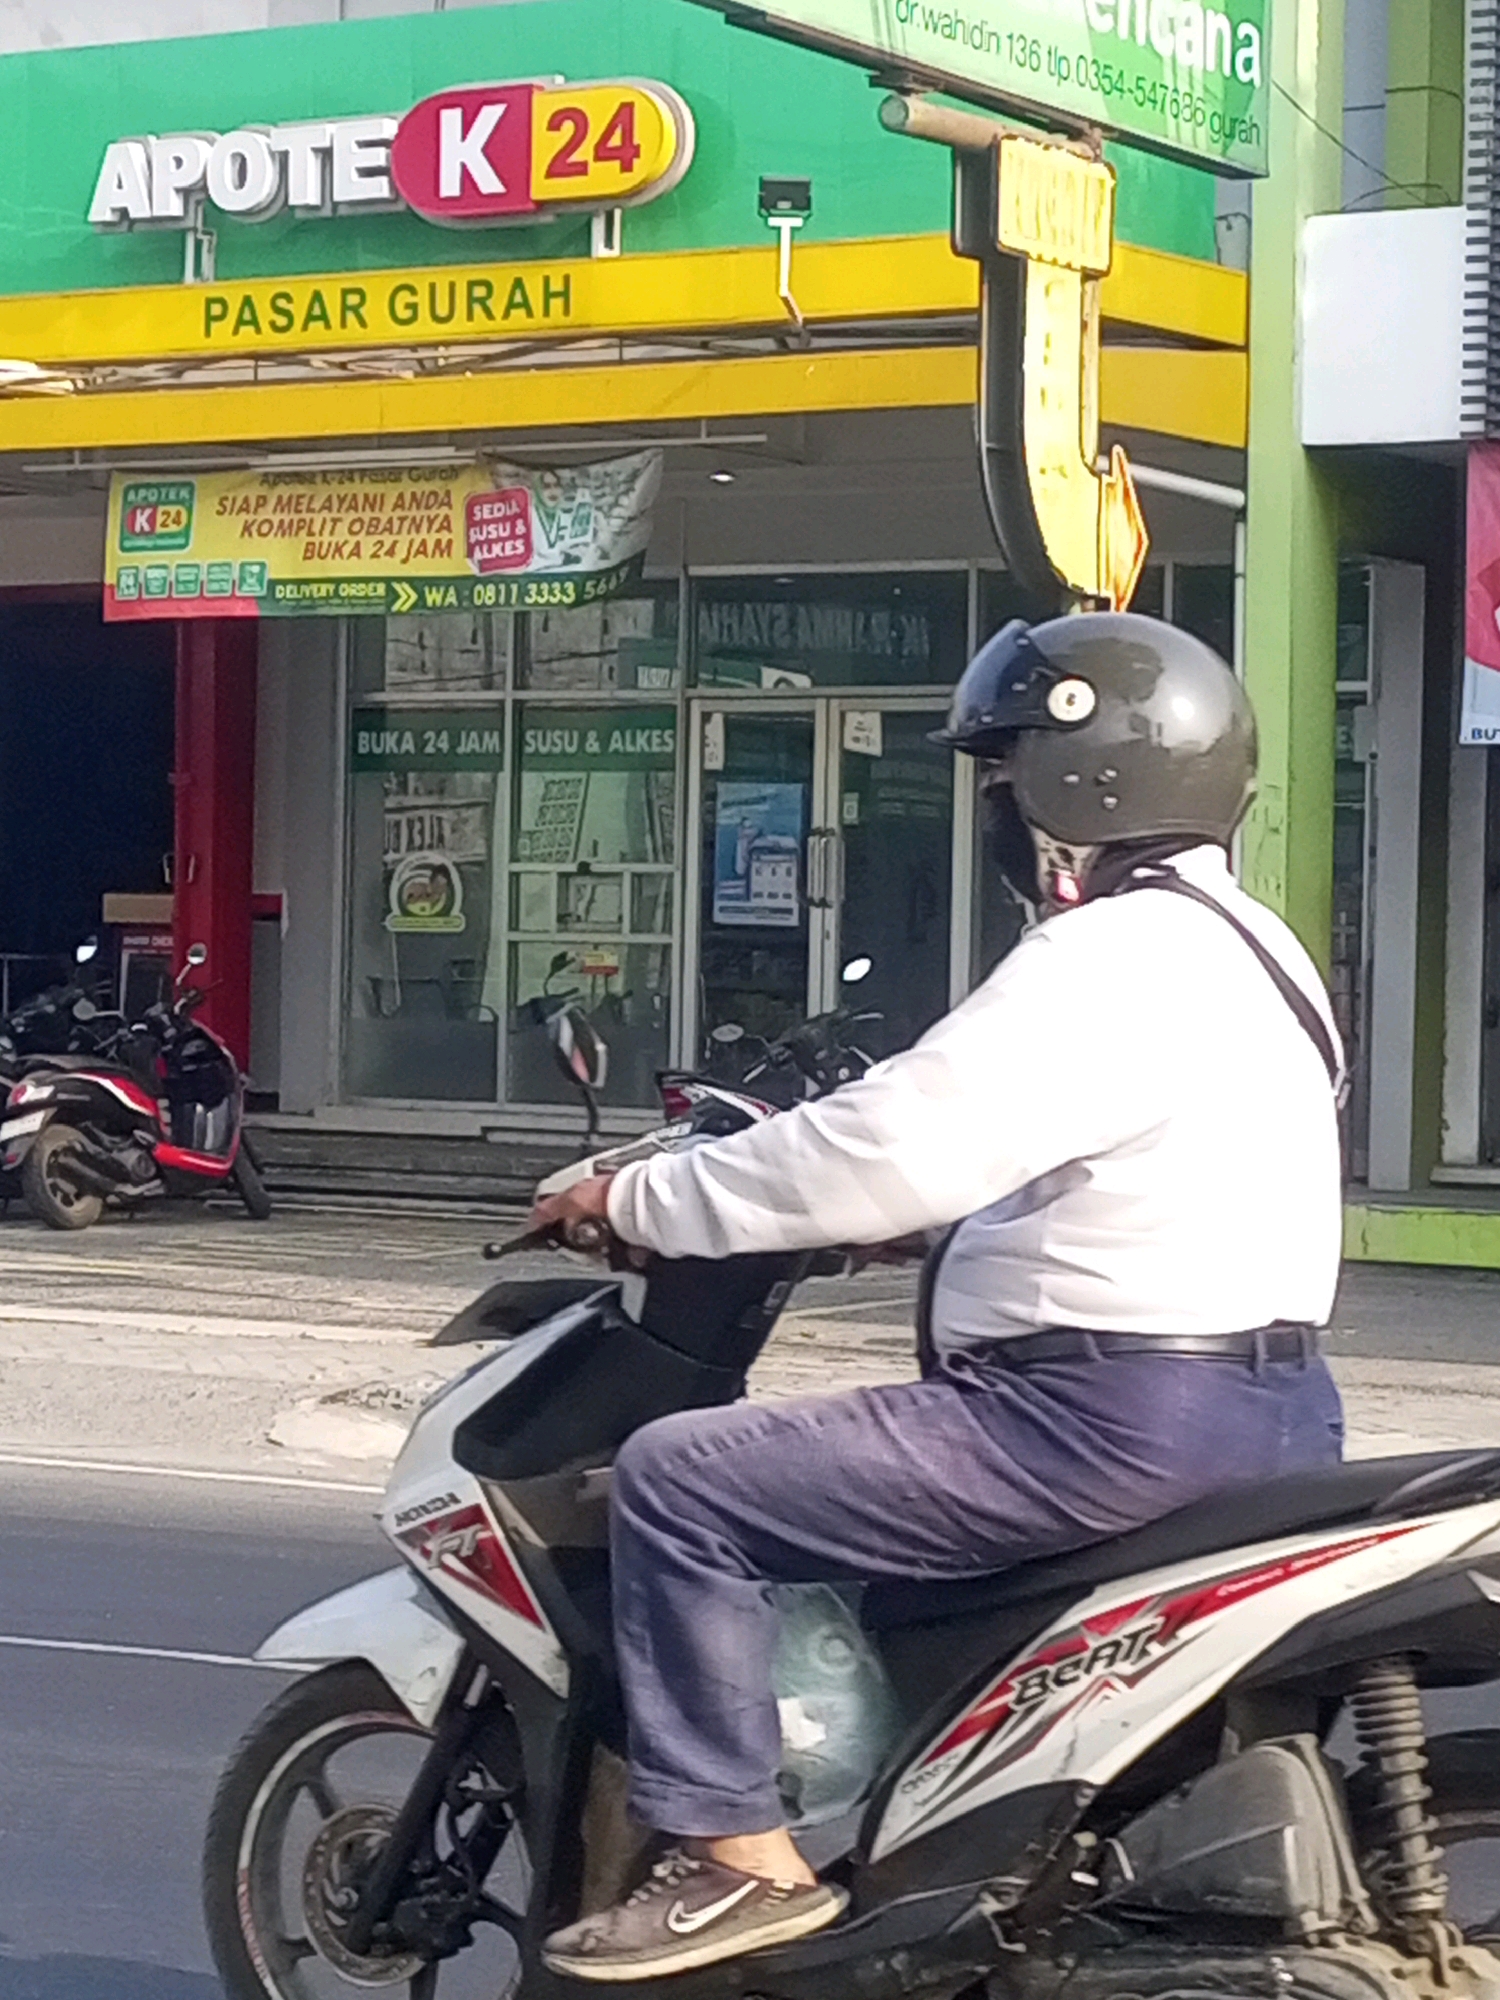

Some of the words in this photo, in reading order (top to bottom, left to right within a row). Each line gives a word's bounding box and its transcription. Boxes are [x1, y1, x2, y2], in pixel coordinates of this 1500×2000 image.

[1006, 32, 1042, 73] 136
[1210, 111, 1260, 146] gurah
[203, 285, 368, 338] PASAR
[388, 273, 572, 326] GURAH
[407, 466, 458, 483] Gurah
[127, 487, 190, 502] APOTEK
[216, 495, 267, 516] SIAP
[272, 492, 385, 516] MELAYANI
[391, 489, 453, 512] ANDA
[473, 499, 520, 521] SEDIA
[240, 517, 343, 539] KOMPLIT
[347, 514, 453, 536] OBATNYA
[469, 521, 511, 544] SUSU
[516, 519, 526, 534] &
[302, 540, 362, 561] BUKA
[370, 540, 399, 558] 24
[400, 538, 453, 564] JAM
[473, 539, 525, 561] ALKES
[275, 582, 335, 599] DELIVERY
[339, 581, 386, 597] ORDER
[474, 583, 518, 606] 0811
[525, 581, 576, 604] 3333
[357, 730, 415, 754] BUKA
[423, 730, 449, 753] 24
[455, 730, 500, 753] JAM
[524, 729, 579, 752] SUSU
[585, 730, 600, 751] &
[608, 729, 675, 752] ALKES
